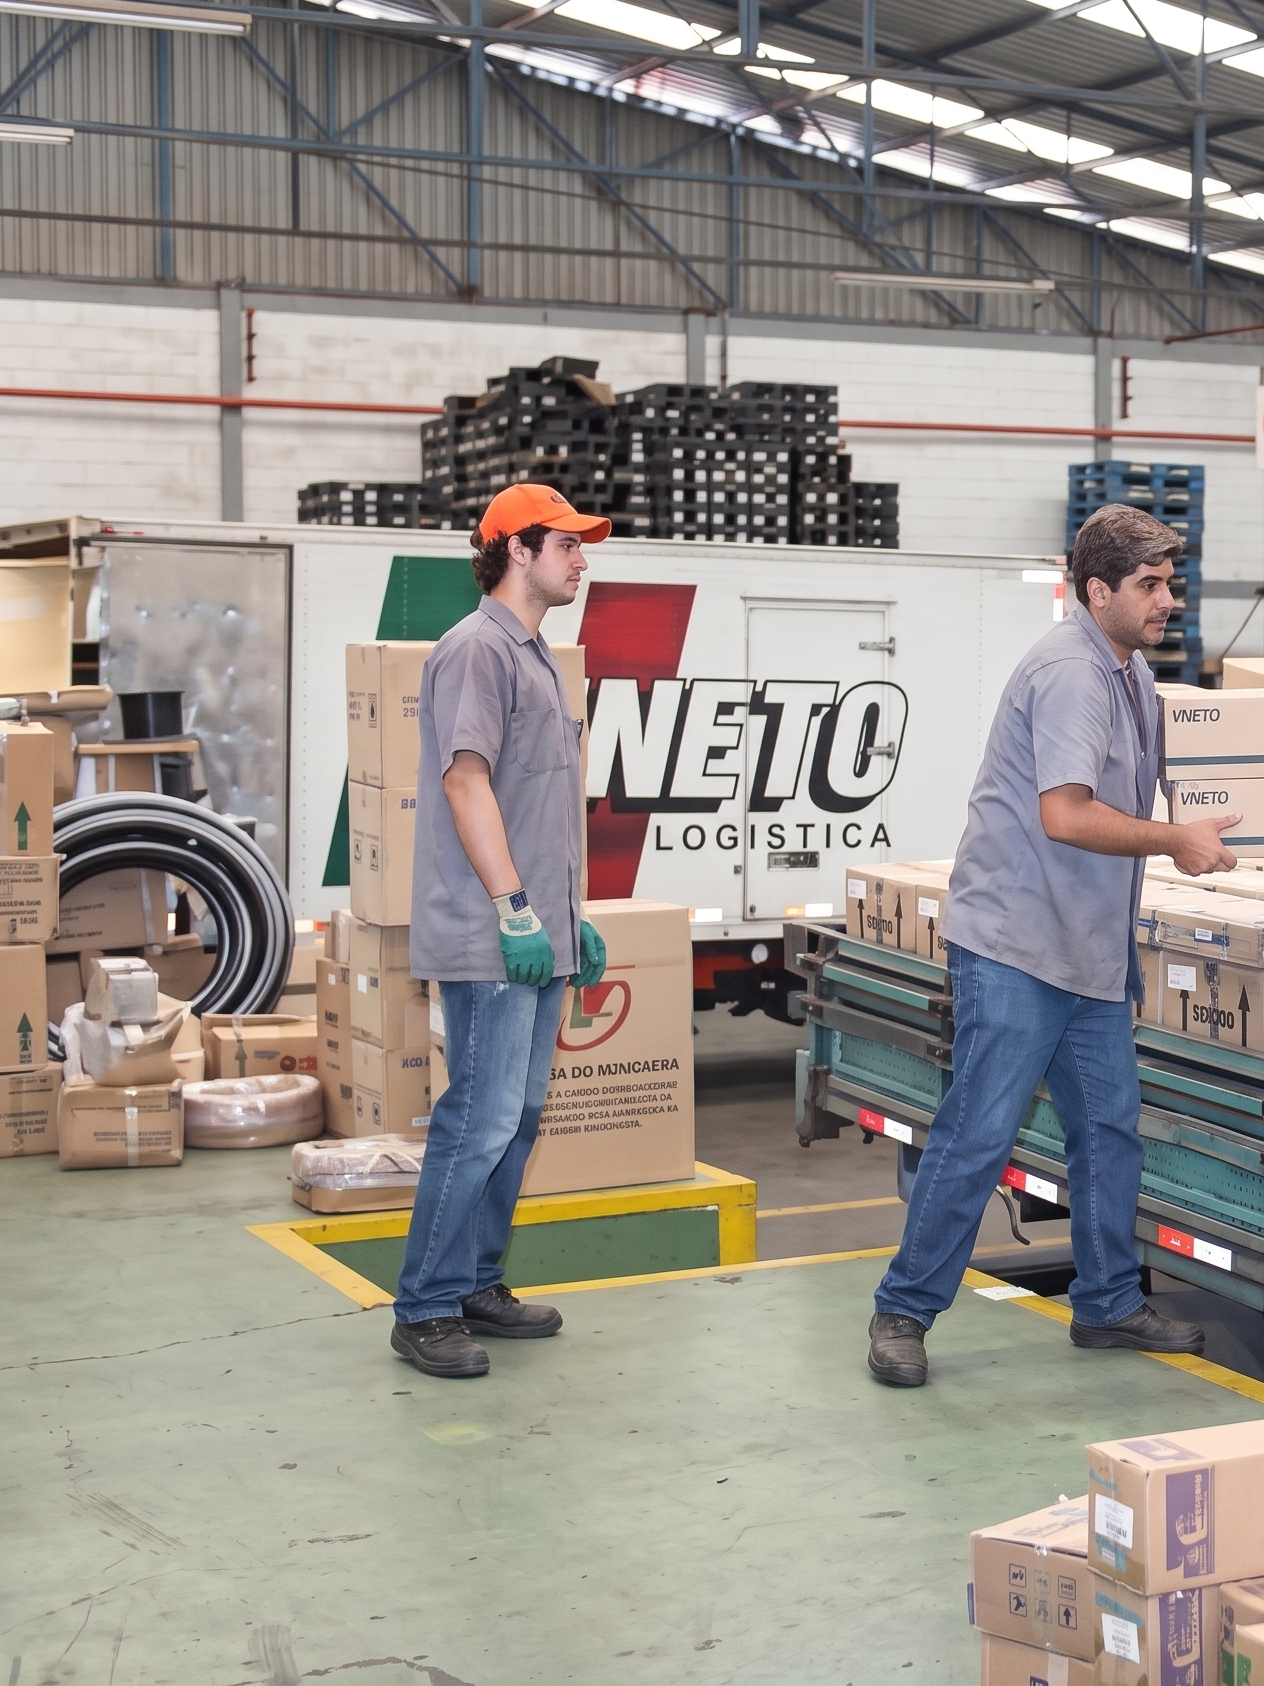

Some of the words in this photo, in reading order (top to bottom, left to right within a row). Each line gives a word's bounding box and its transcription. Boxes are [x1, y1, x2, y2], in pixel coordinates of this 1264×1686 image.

[1172, 708, 1221, 723] VNETO
[586, 677, 909, 814] NETO
[1180, 790, 1229, 806] VNETO
[655, 822, 893, 851] LOGISTICA
[571, 1065, 594, 1079] DO
